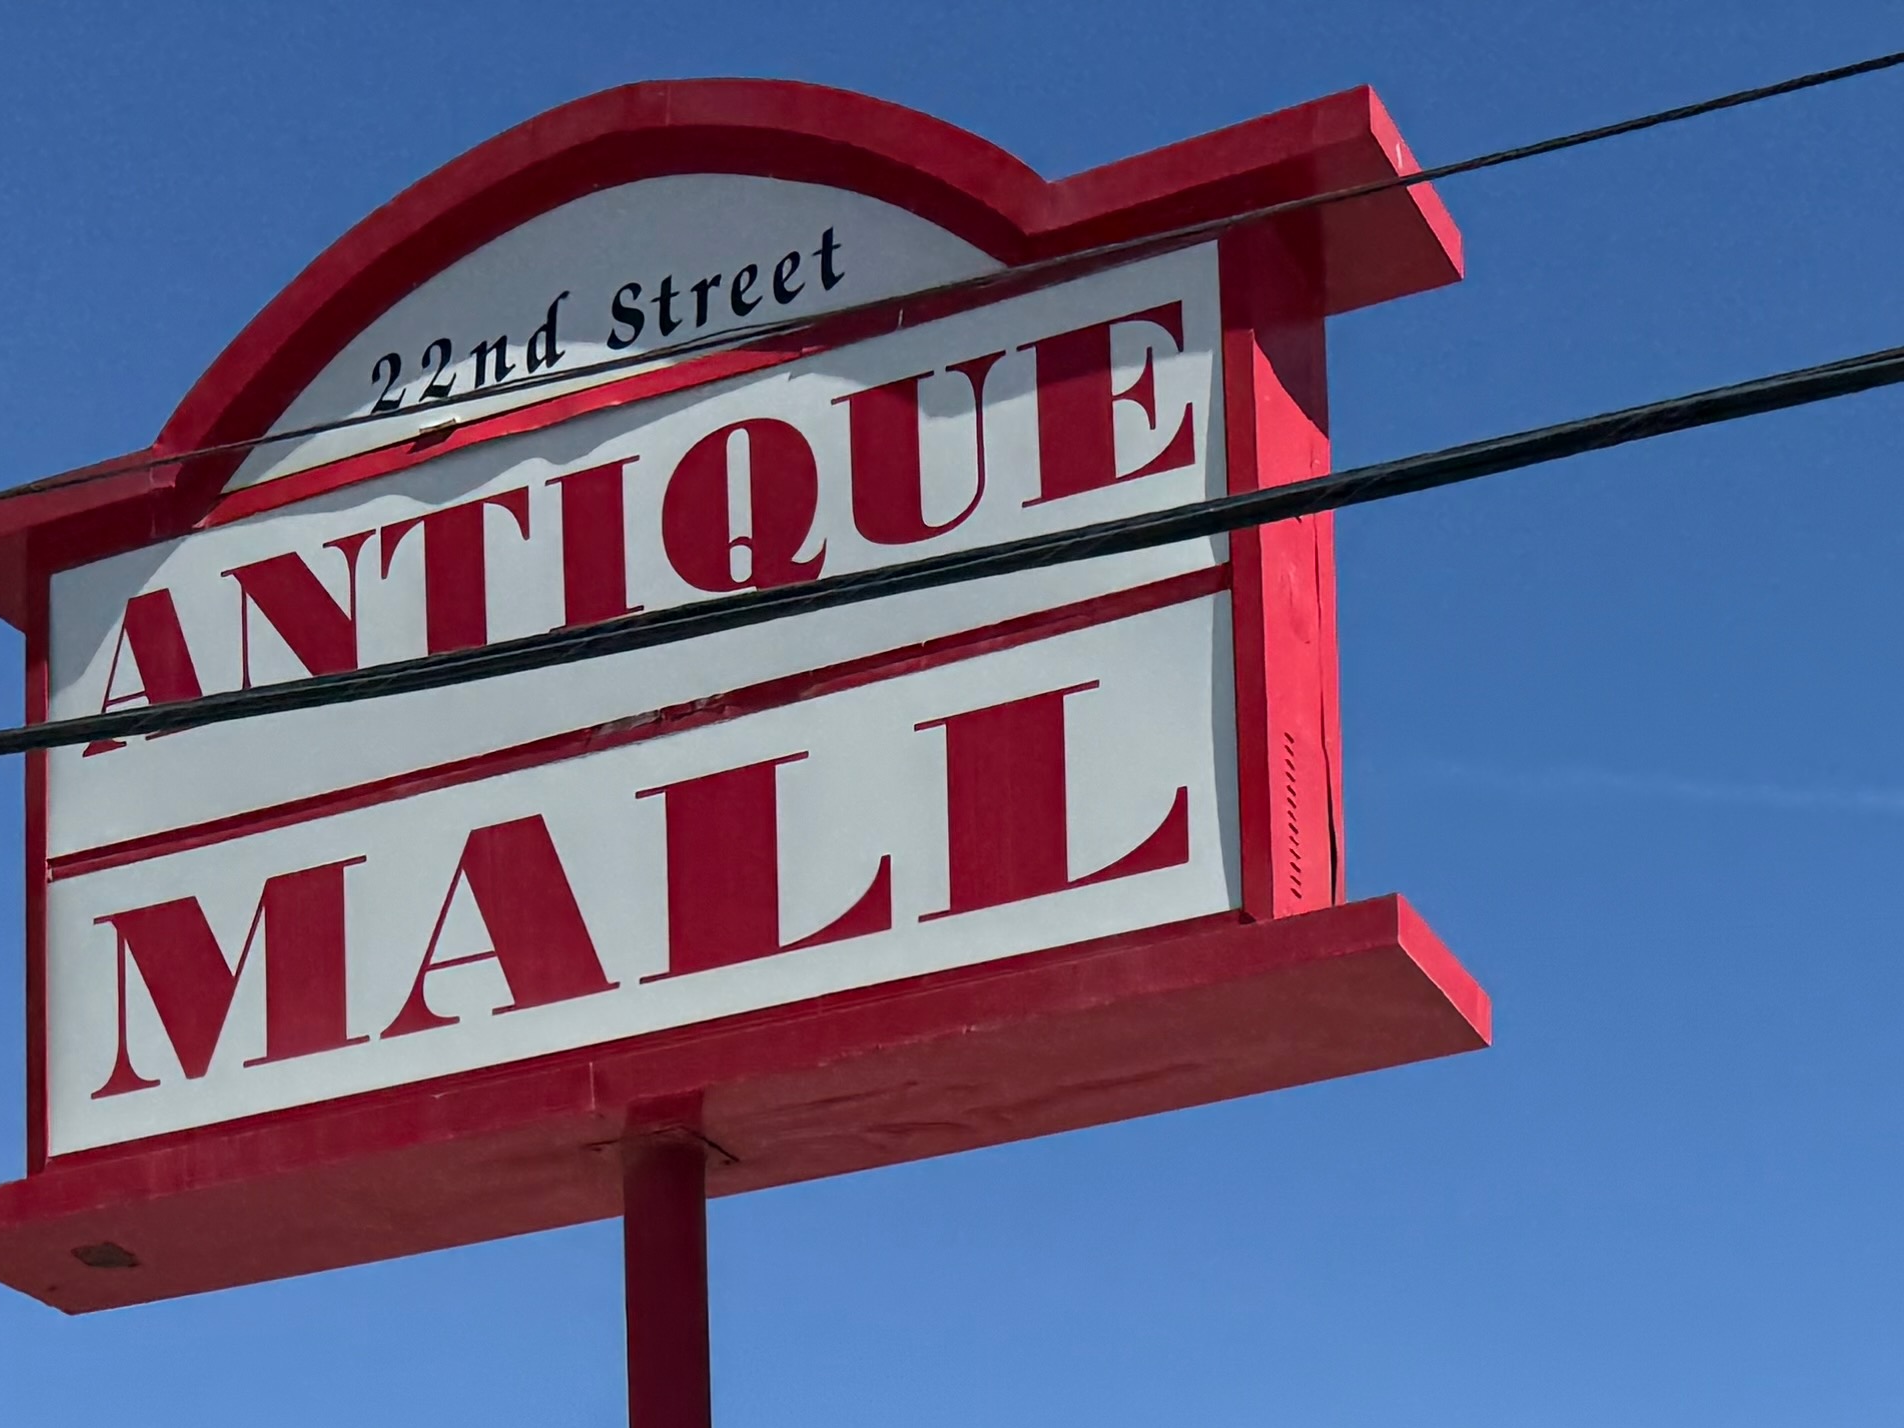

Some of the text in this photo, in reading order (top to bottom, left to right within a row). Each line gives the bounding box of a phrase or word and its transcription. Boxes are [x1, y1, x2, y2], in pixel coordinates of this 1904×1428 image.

[82, 299, 1195, 758] ANTIQUE
[369, 225, 846, 416] 22nd Street
[90, 679, 1190, 1099] MALL
